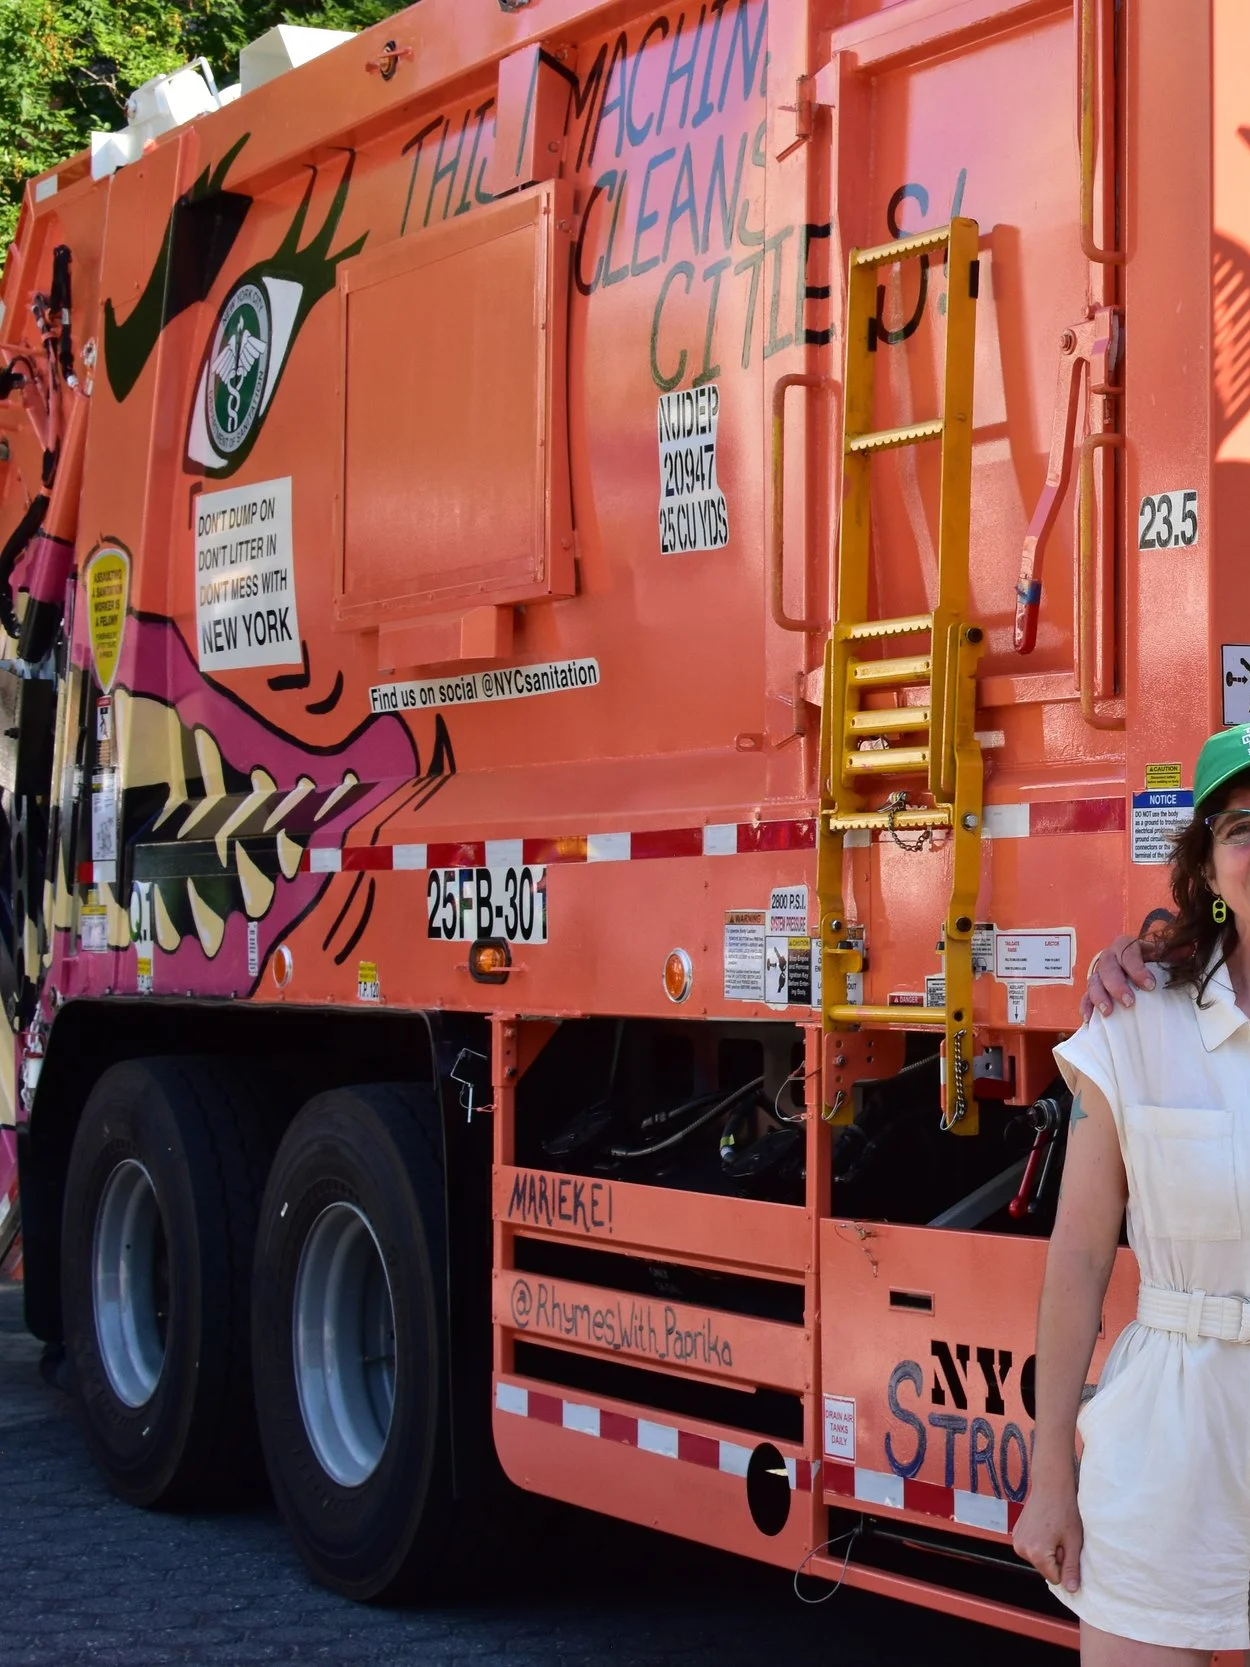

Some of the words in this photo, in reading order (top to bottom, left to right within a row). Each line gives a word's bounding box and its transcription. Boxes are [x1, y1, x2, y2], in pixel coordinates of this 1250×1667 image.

[516, 0, 770, 177] MACHIN
[659, 386, 719, 443] NJDEP
[664, 443, 714, 497] 20947
[197, 508, 228, 537] DON'T
[228, 502, 258, 530] DUMP
[259, 497, 276, 522] ON
[660, 507, 676, 554] 25
[677, 501, 697, 552] CU
[698, 495, 728, 546] YDS
[1139, 491, 1198, 549] 23.5
[198, 543, 228, 572] DON'T
[229, 536, 264, 566] LITTER
[266, 533, 277, 557] IN
[200, 579, 230, 607] DON'T
[230, 573, 259, 600] MESS
[261, 568, 288, 595] WITH
[202, 615, 238, 655] NEW
[242, 606, 293, 648] YORK
[370, 685, 398, 711] Find
[401, 688, 417, 708] us
[419, 687, 437, 705] on
[439, 675, 478, 702] social
[481, 661, 598, 698] @NYCsanitation
[1149, 794, 1177, 805] NOTICE
[1168, 810, 1179, 818] body
[427, 867, 547, 940] 25FB-301
[735, 914, 761, 923] WARNING
[771, 894, 788, 909] 2800
[789, 894, 806, 910] P.S.I.
[770, 916, 786, 932] SYSTEM
[787, 916, 806, 932] PRESSURE
[508, 1172, 613, 1234] MARIEKE!
[826, 1409, 843, 1421] DRAIN
[843, 1414, 854, 1422] AIR
[830, 1422, 849, 1434] TANKS
[884, 1360, 1037, 1502] STRO
[831, 1435, 848, 1446] DAILY
